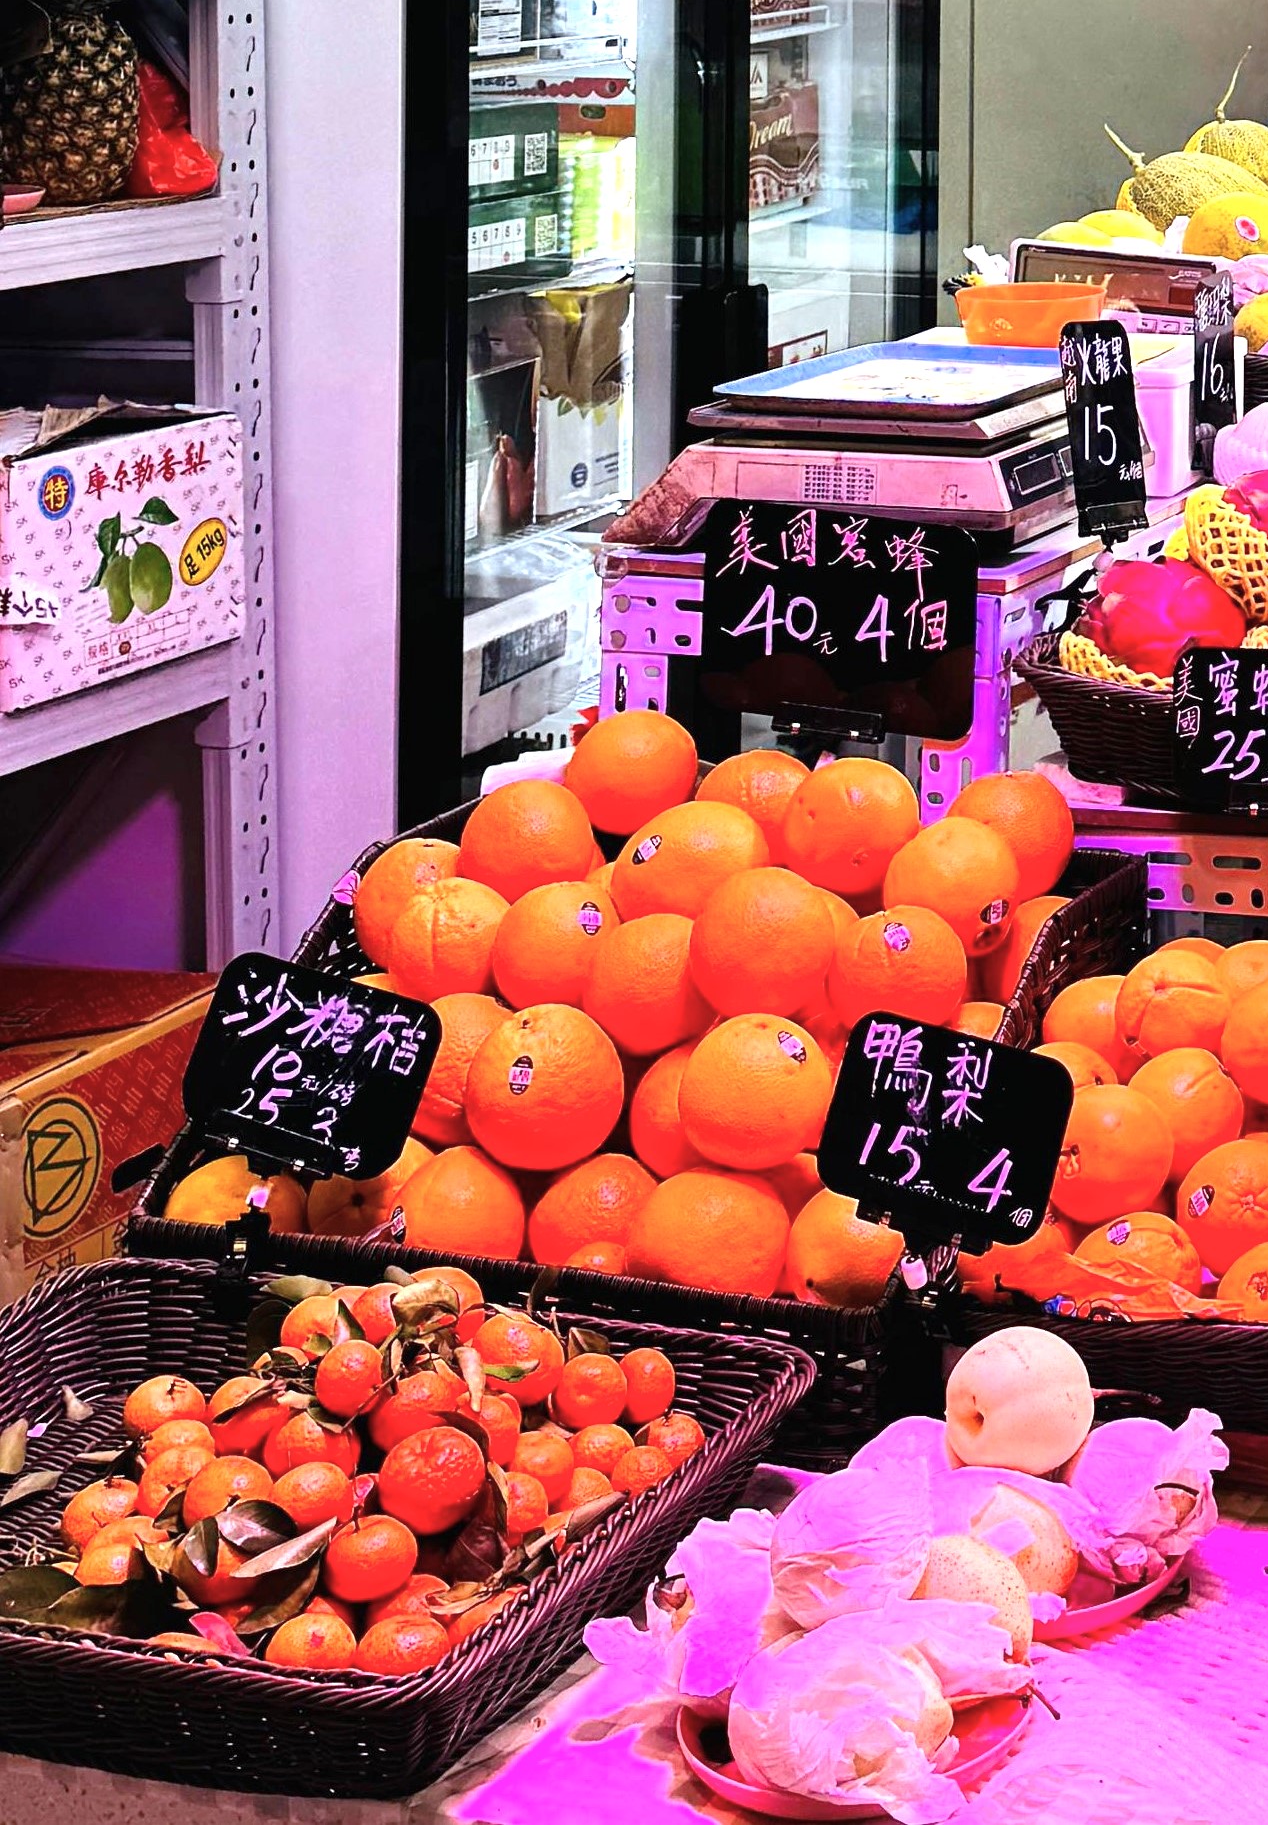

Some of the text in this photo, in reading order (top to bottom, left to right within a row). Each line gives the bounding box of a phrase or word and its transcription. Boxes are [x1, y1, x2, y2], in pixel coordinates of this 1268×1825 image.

[1201, 332, 1224, 401] 16
[1084, 403, 1117, 466] 15
[43, 478, 69, 513] 特
[196, 527, 225, 562] 15kg
[1201, 728, 1266, 781] 25
[862, 1019, 993, 1127] 鴨梨
[858, 1122, 928, 1186] 15
